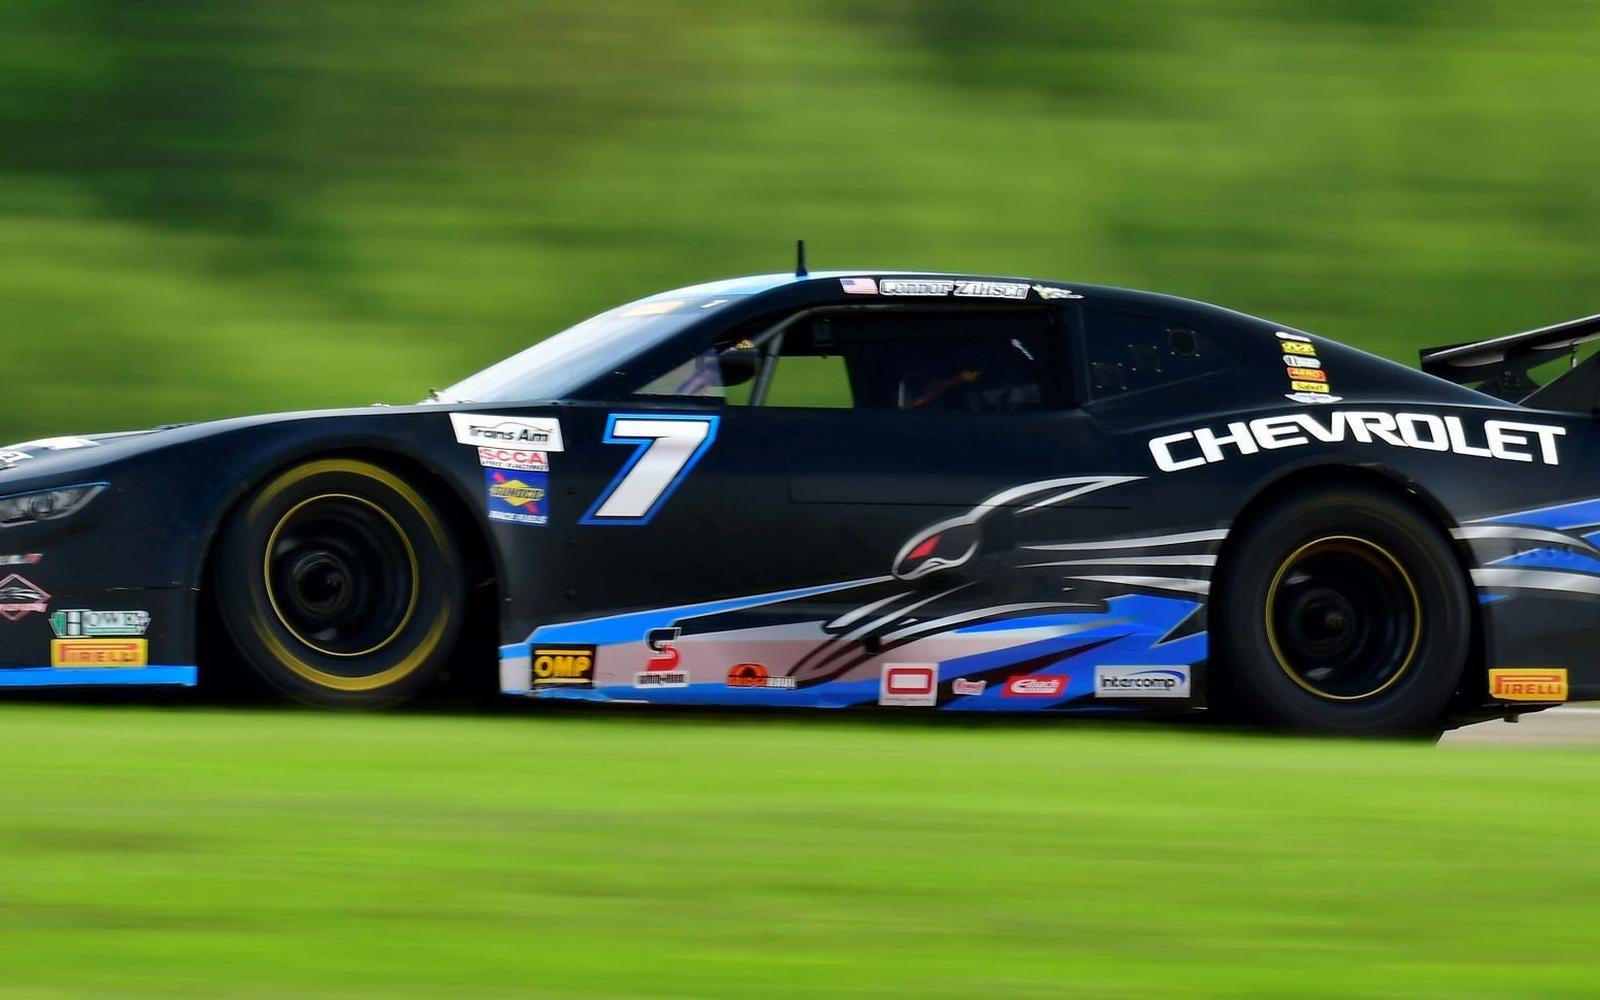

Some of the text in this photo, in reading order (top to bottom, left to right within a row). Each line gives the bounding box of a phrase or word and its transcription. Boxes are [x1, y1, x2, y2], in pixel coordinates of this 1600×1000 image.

[1148, 411, 1566, 472] CHEVROLET
[480, 448, 543, 465] SCCA
[576, 413, 720, 526] 7
[60, 643, 139, 663] PIRELLI
[533, 655, 592, 678] OMP
[1495, 674, 1562, 695] PIRELLI
